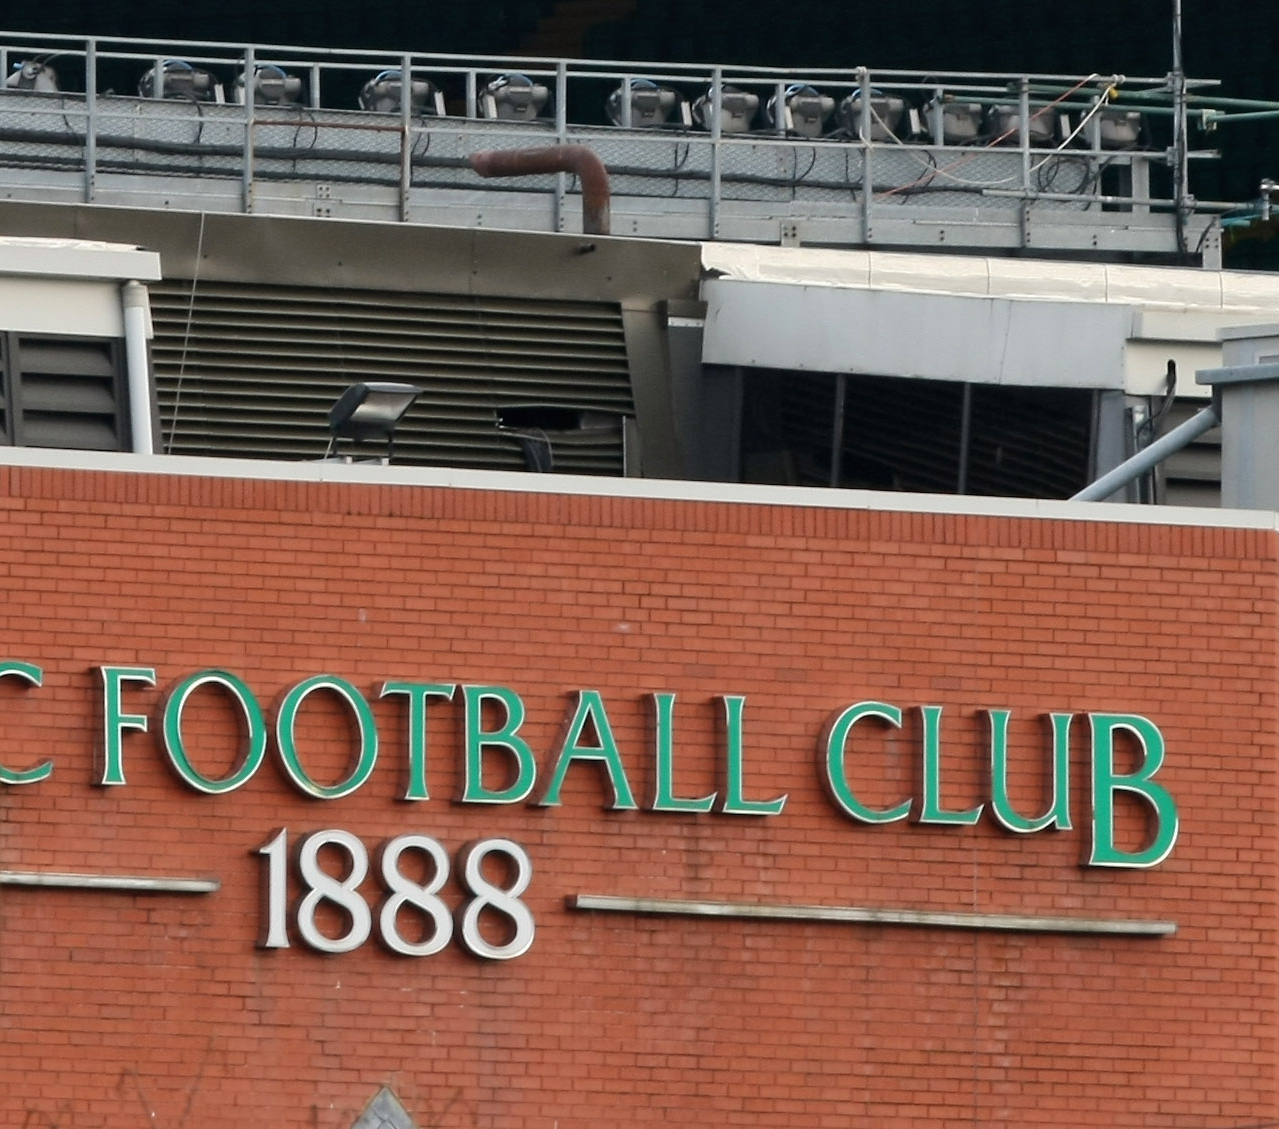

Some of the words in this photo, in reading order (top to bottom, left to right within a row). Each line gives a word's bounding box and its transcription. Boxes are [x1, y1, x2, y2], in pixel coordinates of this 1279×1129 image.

[93, 665, 788, 815] FOOTBALL
[822, 700, 1179, 869] CLUB
[259, 826, 535, 960] 1888
